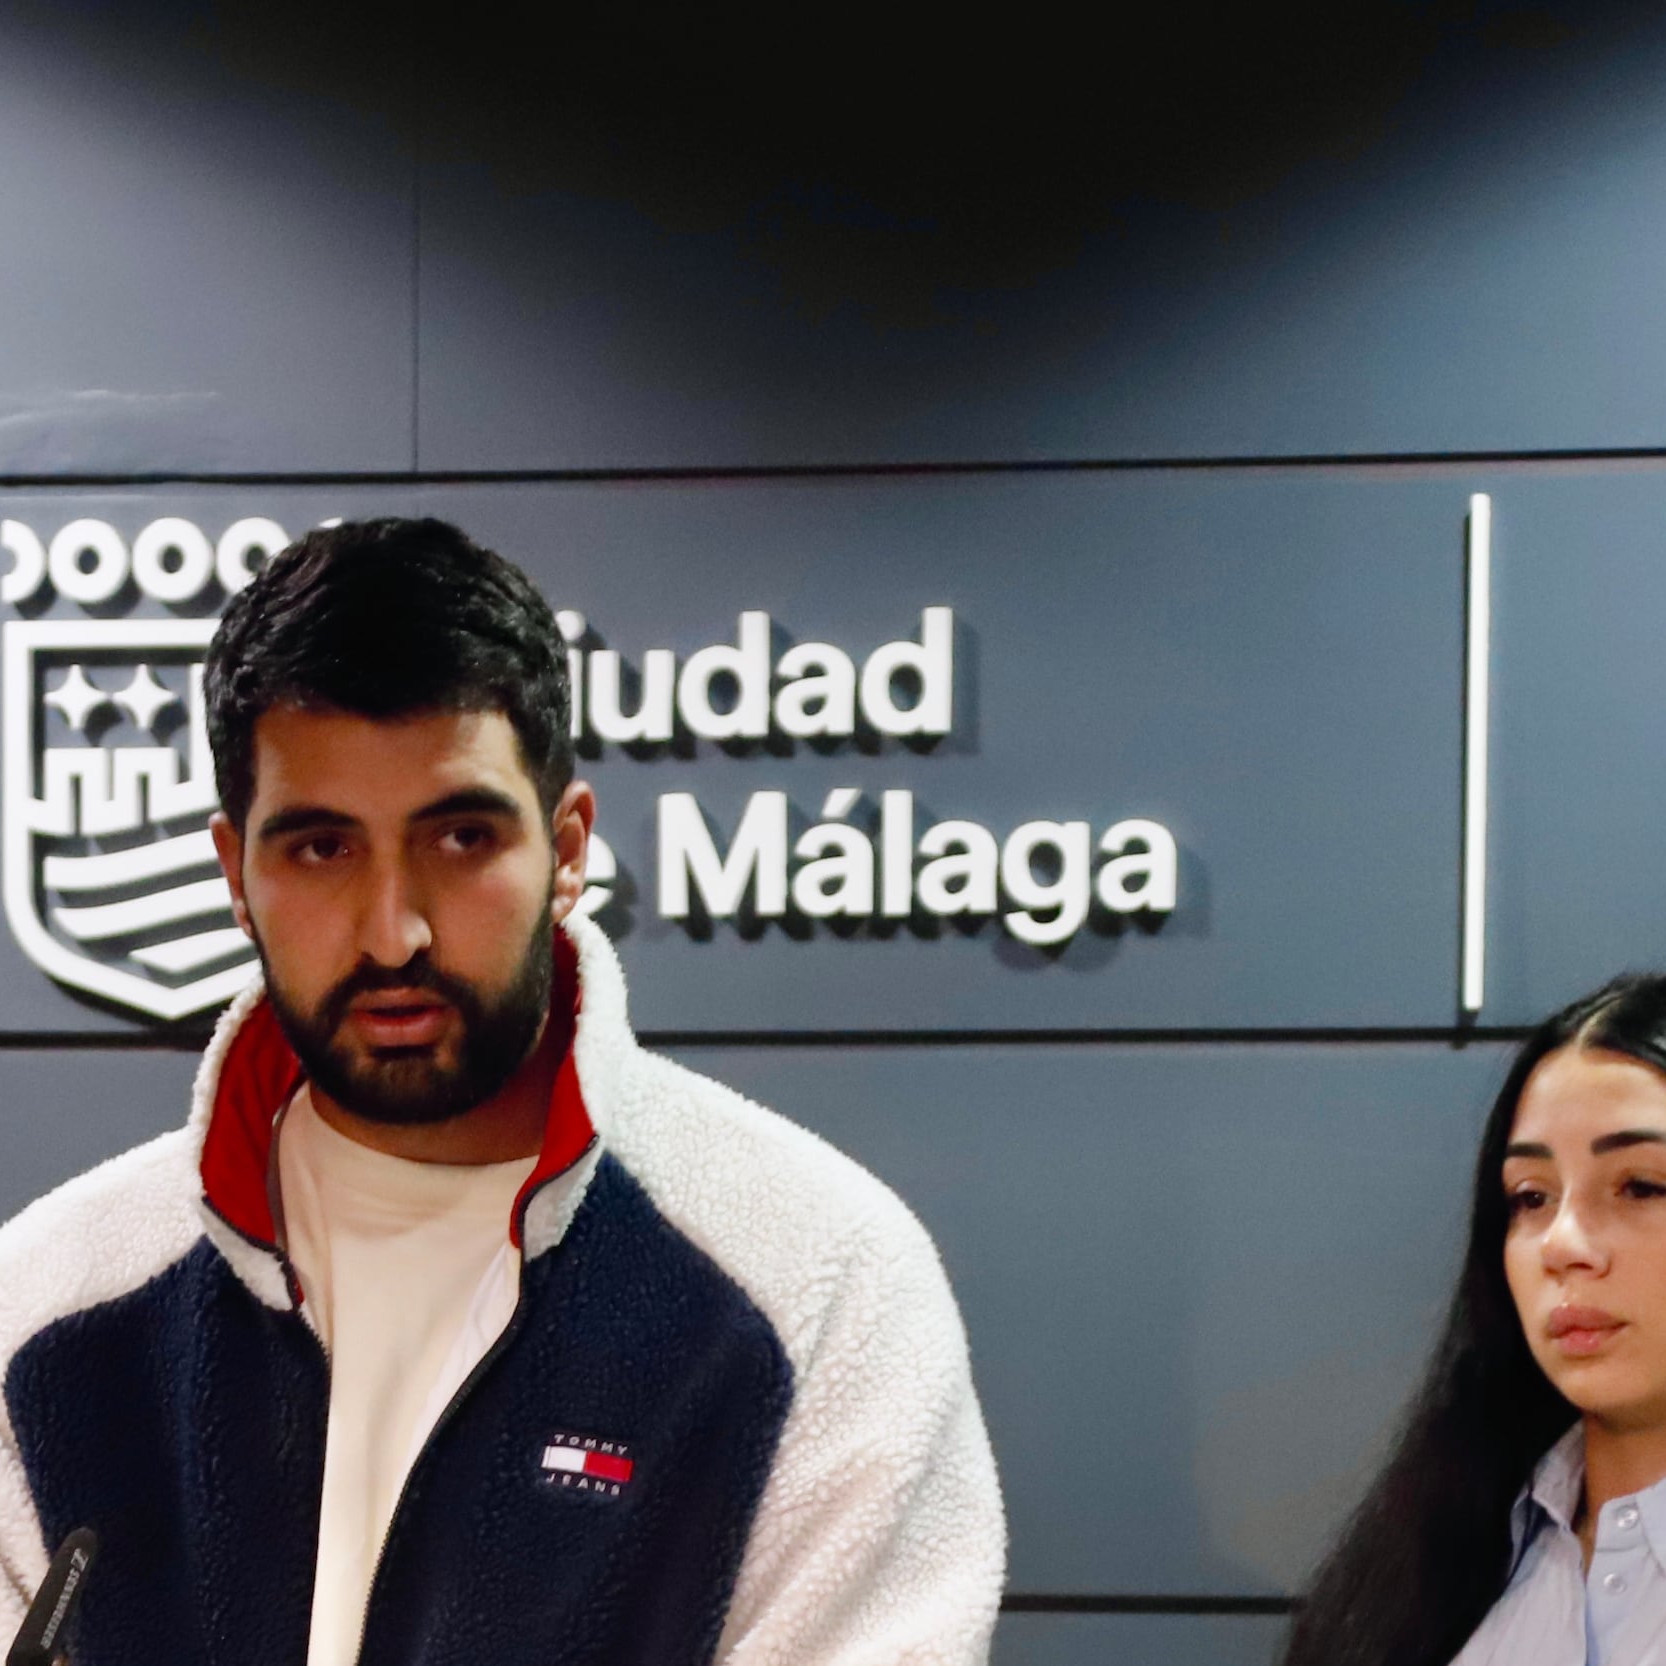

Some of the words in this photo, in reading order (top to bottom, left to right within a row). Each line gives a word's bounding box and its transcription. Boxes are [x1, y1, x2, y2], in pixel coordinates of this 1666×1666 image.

[554, 605, 954, 742] iudad
[657, 787, 1178, 946] Málaga
[554, 1433, 628, 1455] TOMMY
[545, 1473, 621, 1497] JEANS
